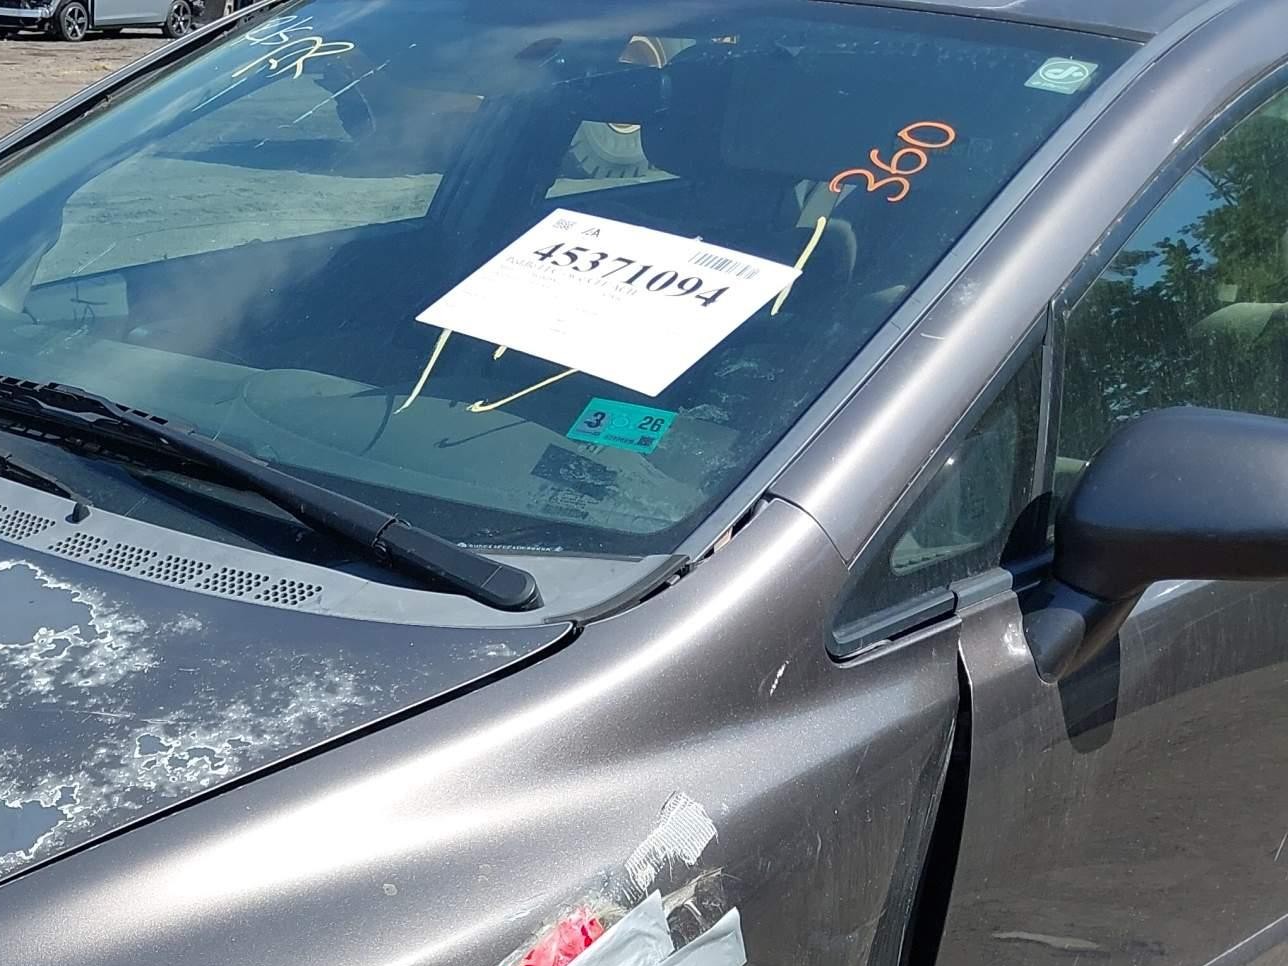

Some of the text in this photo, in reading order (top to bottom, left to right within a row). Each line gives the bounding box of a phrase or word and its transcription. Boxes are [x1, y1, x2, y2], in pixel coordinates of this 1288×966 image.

[828, 121, 956, 203] 360
[533, 242, 730, 307] 45371094
[584, 411, 665, 433] 3 26
